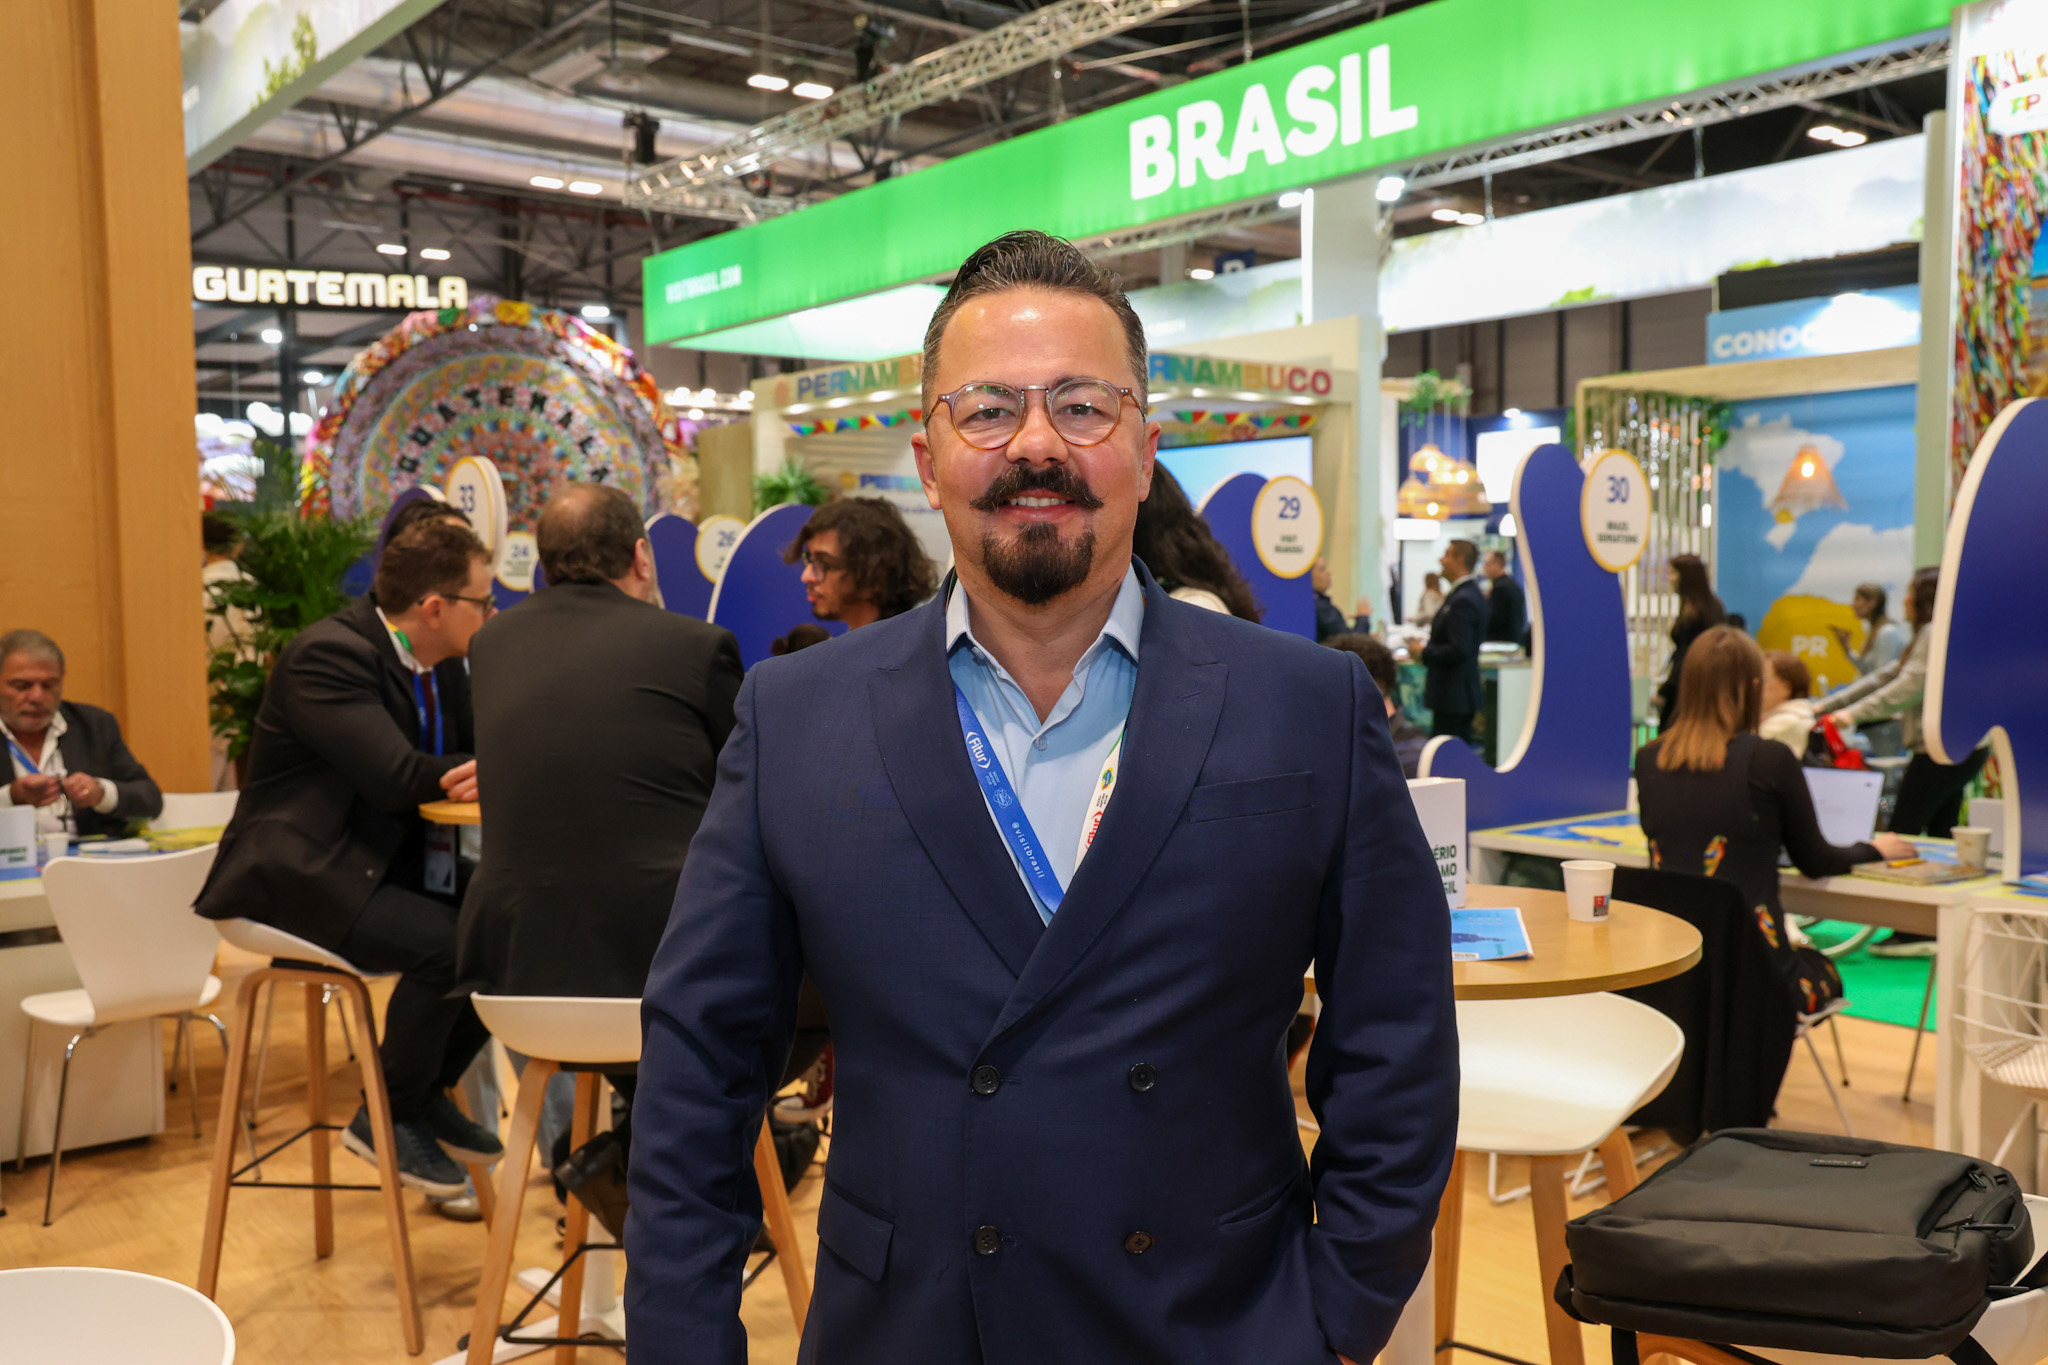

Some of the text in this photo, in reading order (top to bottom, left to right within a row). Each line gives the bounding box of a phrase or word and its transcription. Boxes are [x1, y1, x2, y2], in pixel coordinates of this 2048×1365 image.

[1129, 43, 1418, 200] BRASIL
[192, 266, 468, 309] GUATEMALA
[797, 354, 922, 400] PERNAMB
[399, 388, 610, 484] GUATEMALA
[459, 485, 475, 513] 33
[1607, 475, 1630, 504] 30
[1278, 496, 1301, 520] 29
[1791, 634, 1829, 658] PR
[968, 736, 988, 764] Fitur
[1011, 821, 1045, 878] @visitbrasil
[1433, 844, 1457, 860] ÉRIO
